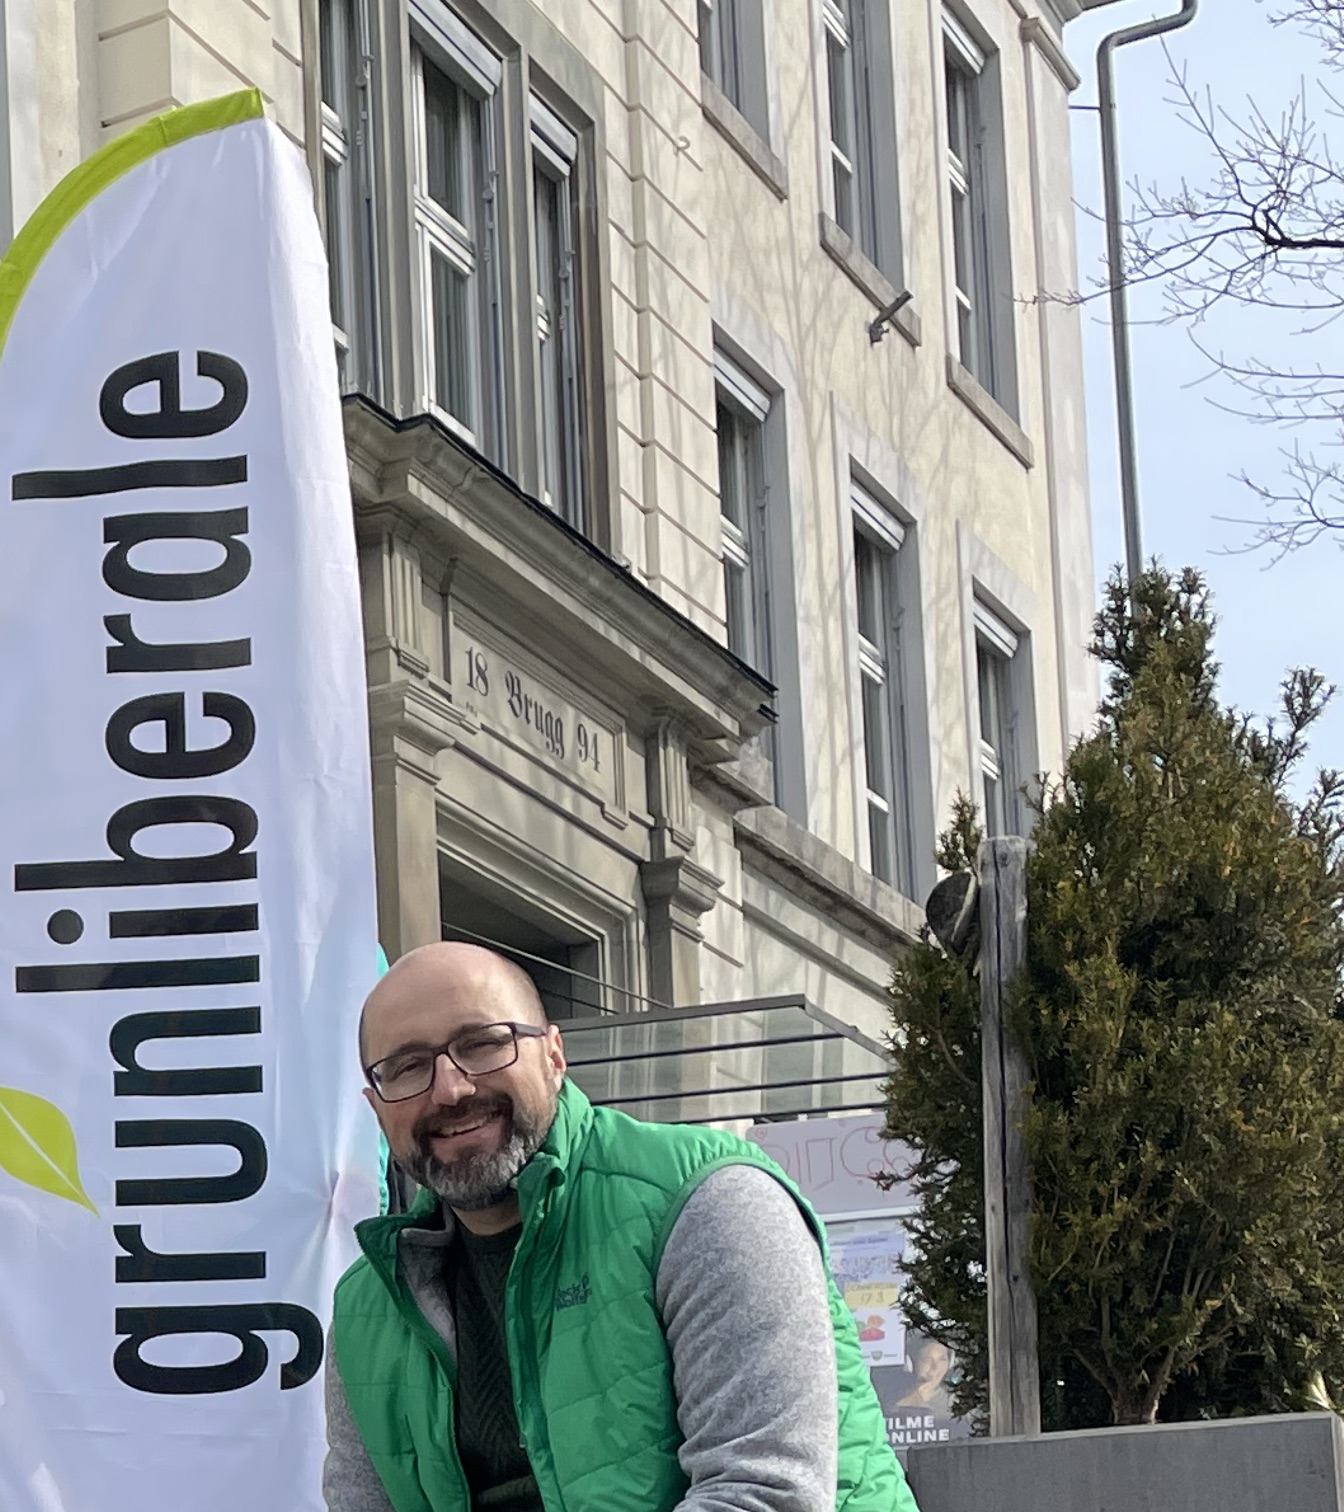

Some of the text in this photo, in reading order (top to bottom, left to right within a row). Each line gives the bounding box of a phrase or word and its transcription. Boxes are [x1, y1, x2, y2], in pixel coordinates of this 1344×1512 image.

[465, 647, 601, 774] 18 Brugg 94
[885, 1415, 935, 1431] ILME
